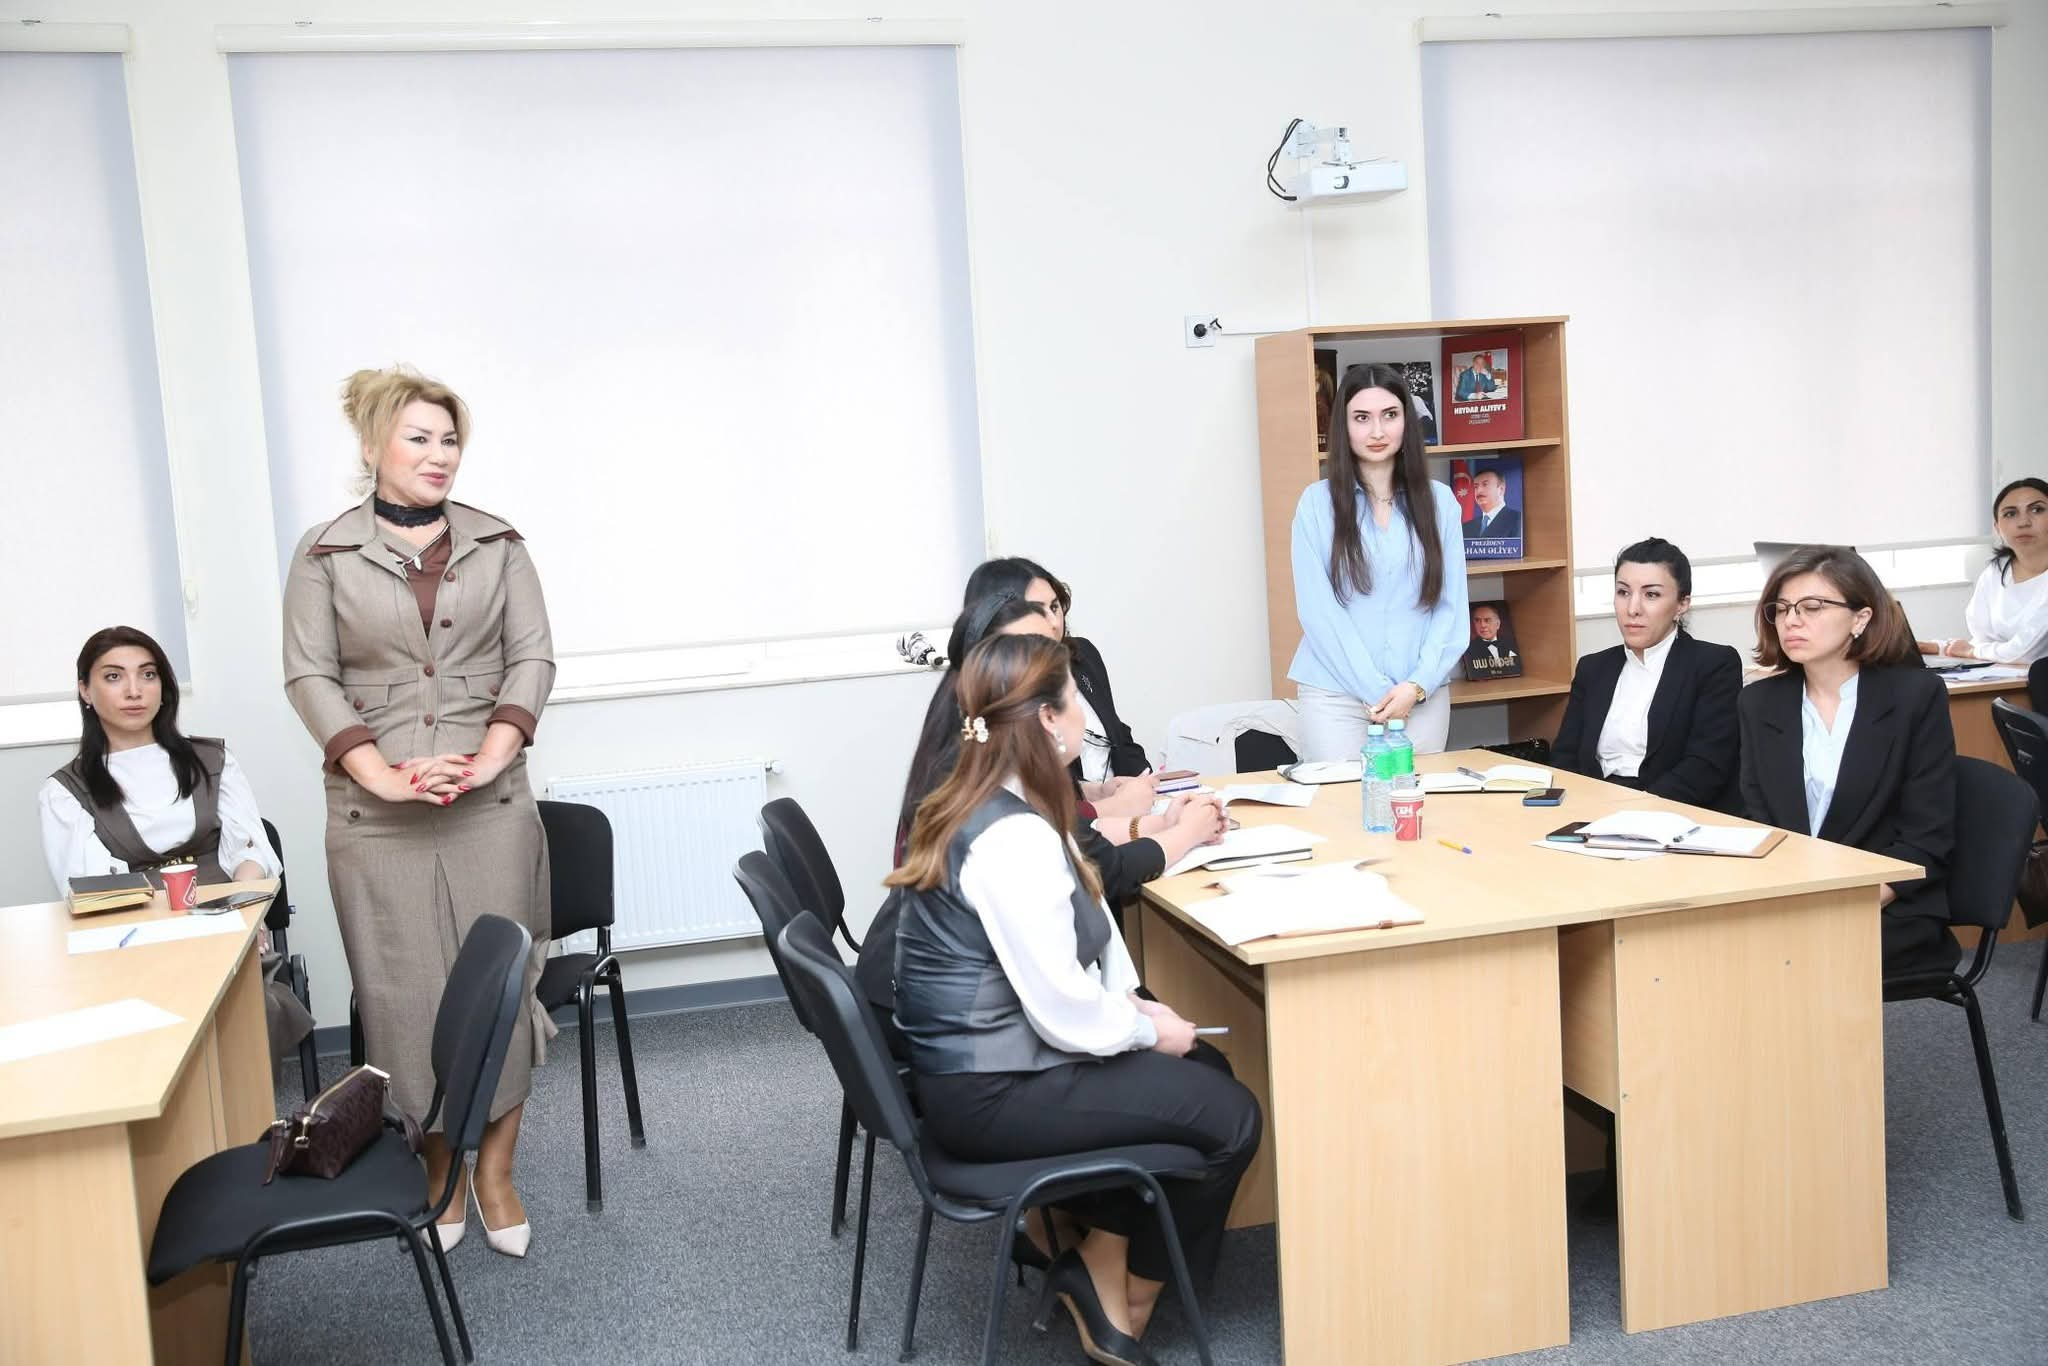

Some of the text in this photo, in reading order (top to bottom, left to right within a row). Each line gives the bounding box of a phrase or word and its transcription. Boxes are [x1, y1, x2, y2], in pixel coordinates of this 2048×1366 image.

[1454, 406, 1479, 415] HEYDAR
[1465, 547, 1485, 555] HAM
[1472, 658, 1488, 669] ULU
